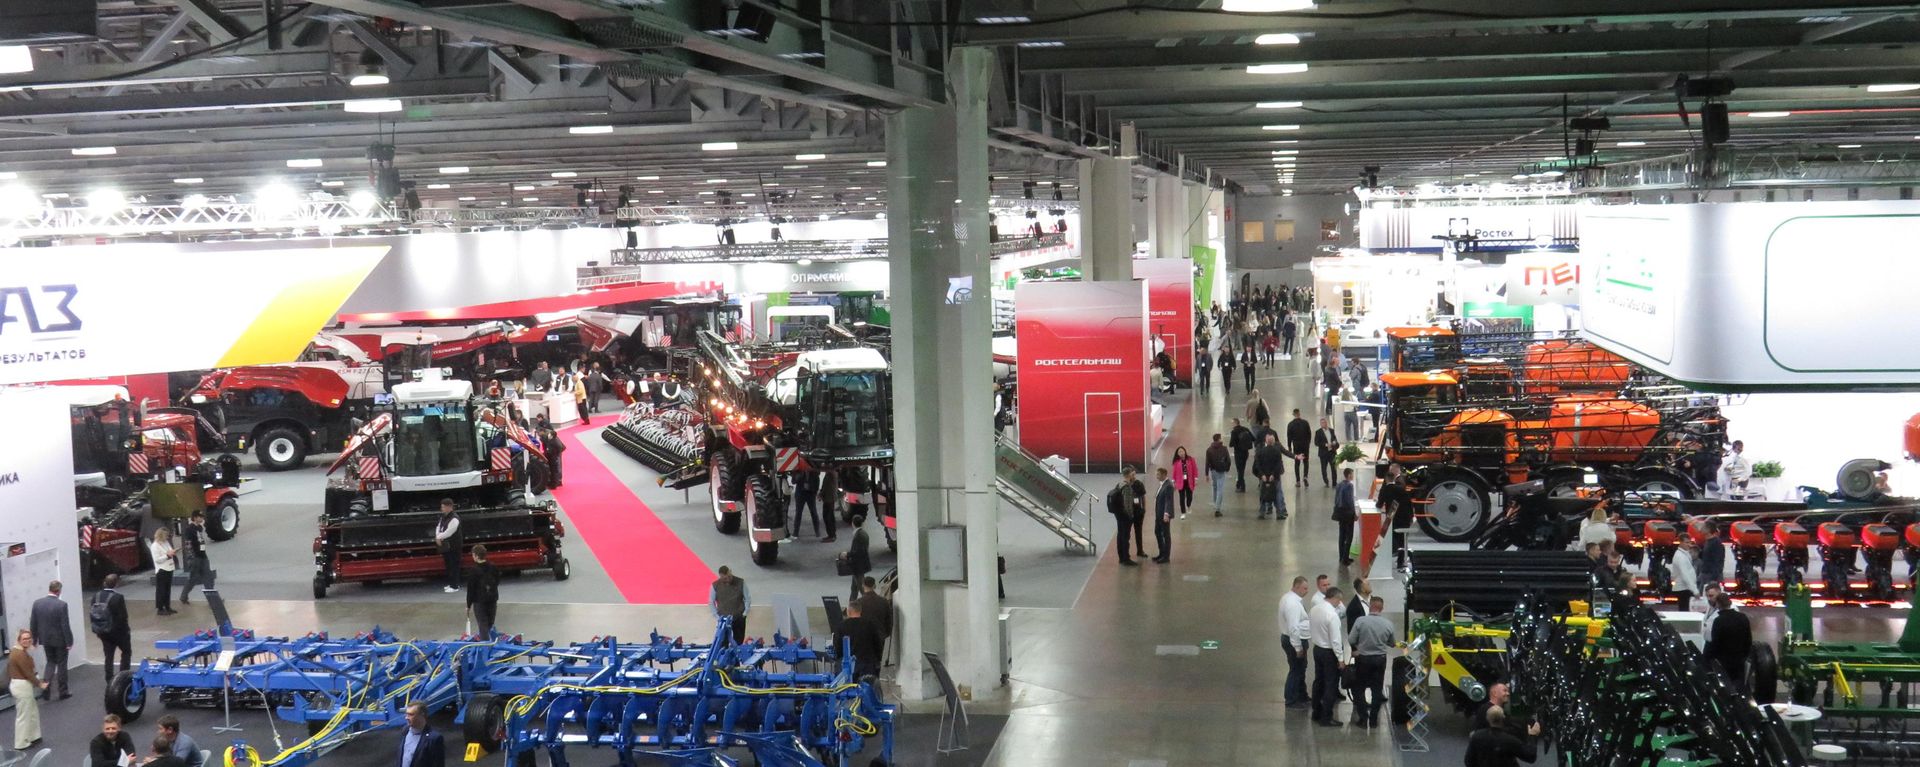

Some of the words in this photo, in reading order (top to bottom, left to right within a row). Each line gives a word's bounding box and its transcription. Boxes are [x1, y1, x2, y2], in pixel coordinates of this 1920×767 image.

[1475, 228, 1514, 238] Ростех
[0, 349, 86, 364] ЕЗУЛЬТАТОВ
[1034, 358, 1122, 366] РОСТСЕЛЬМАШ
